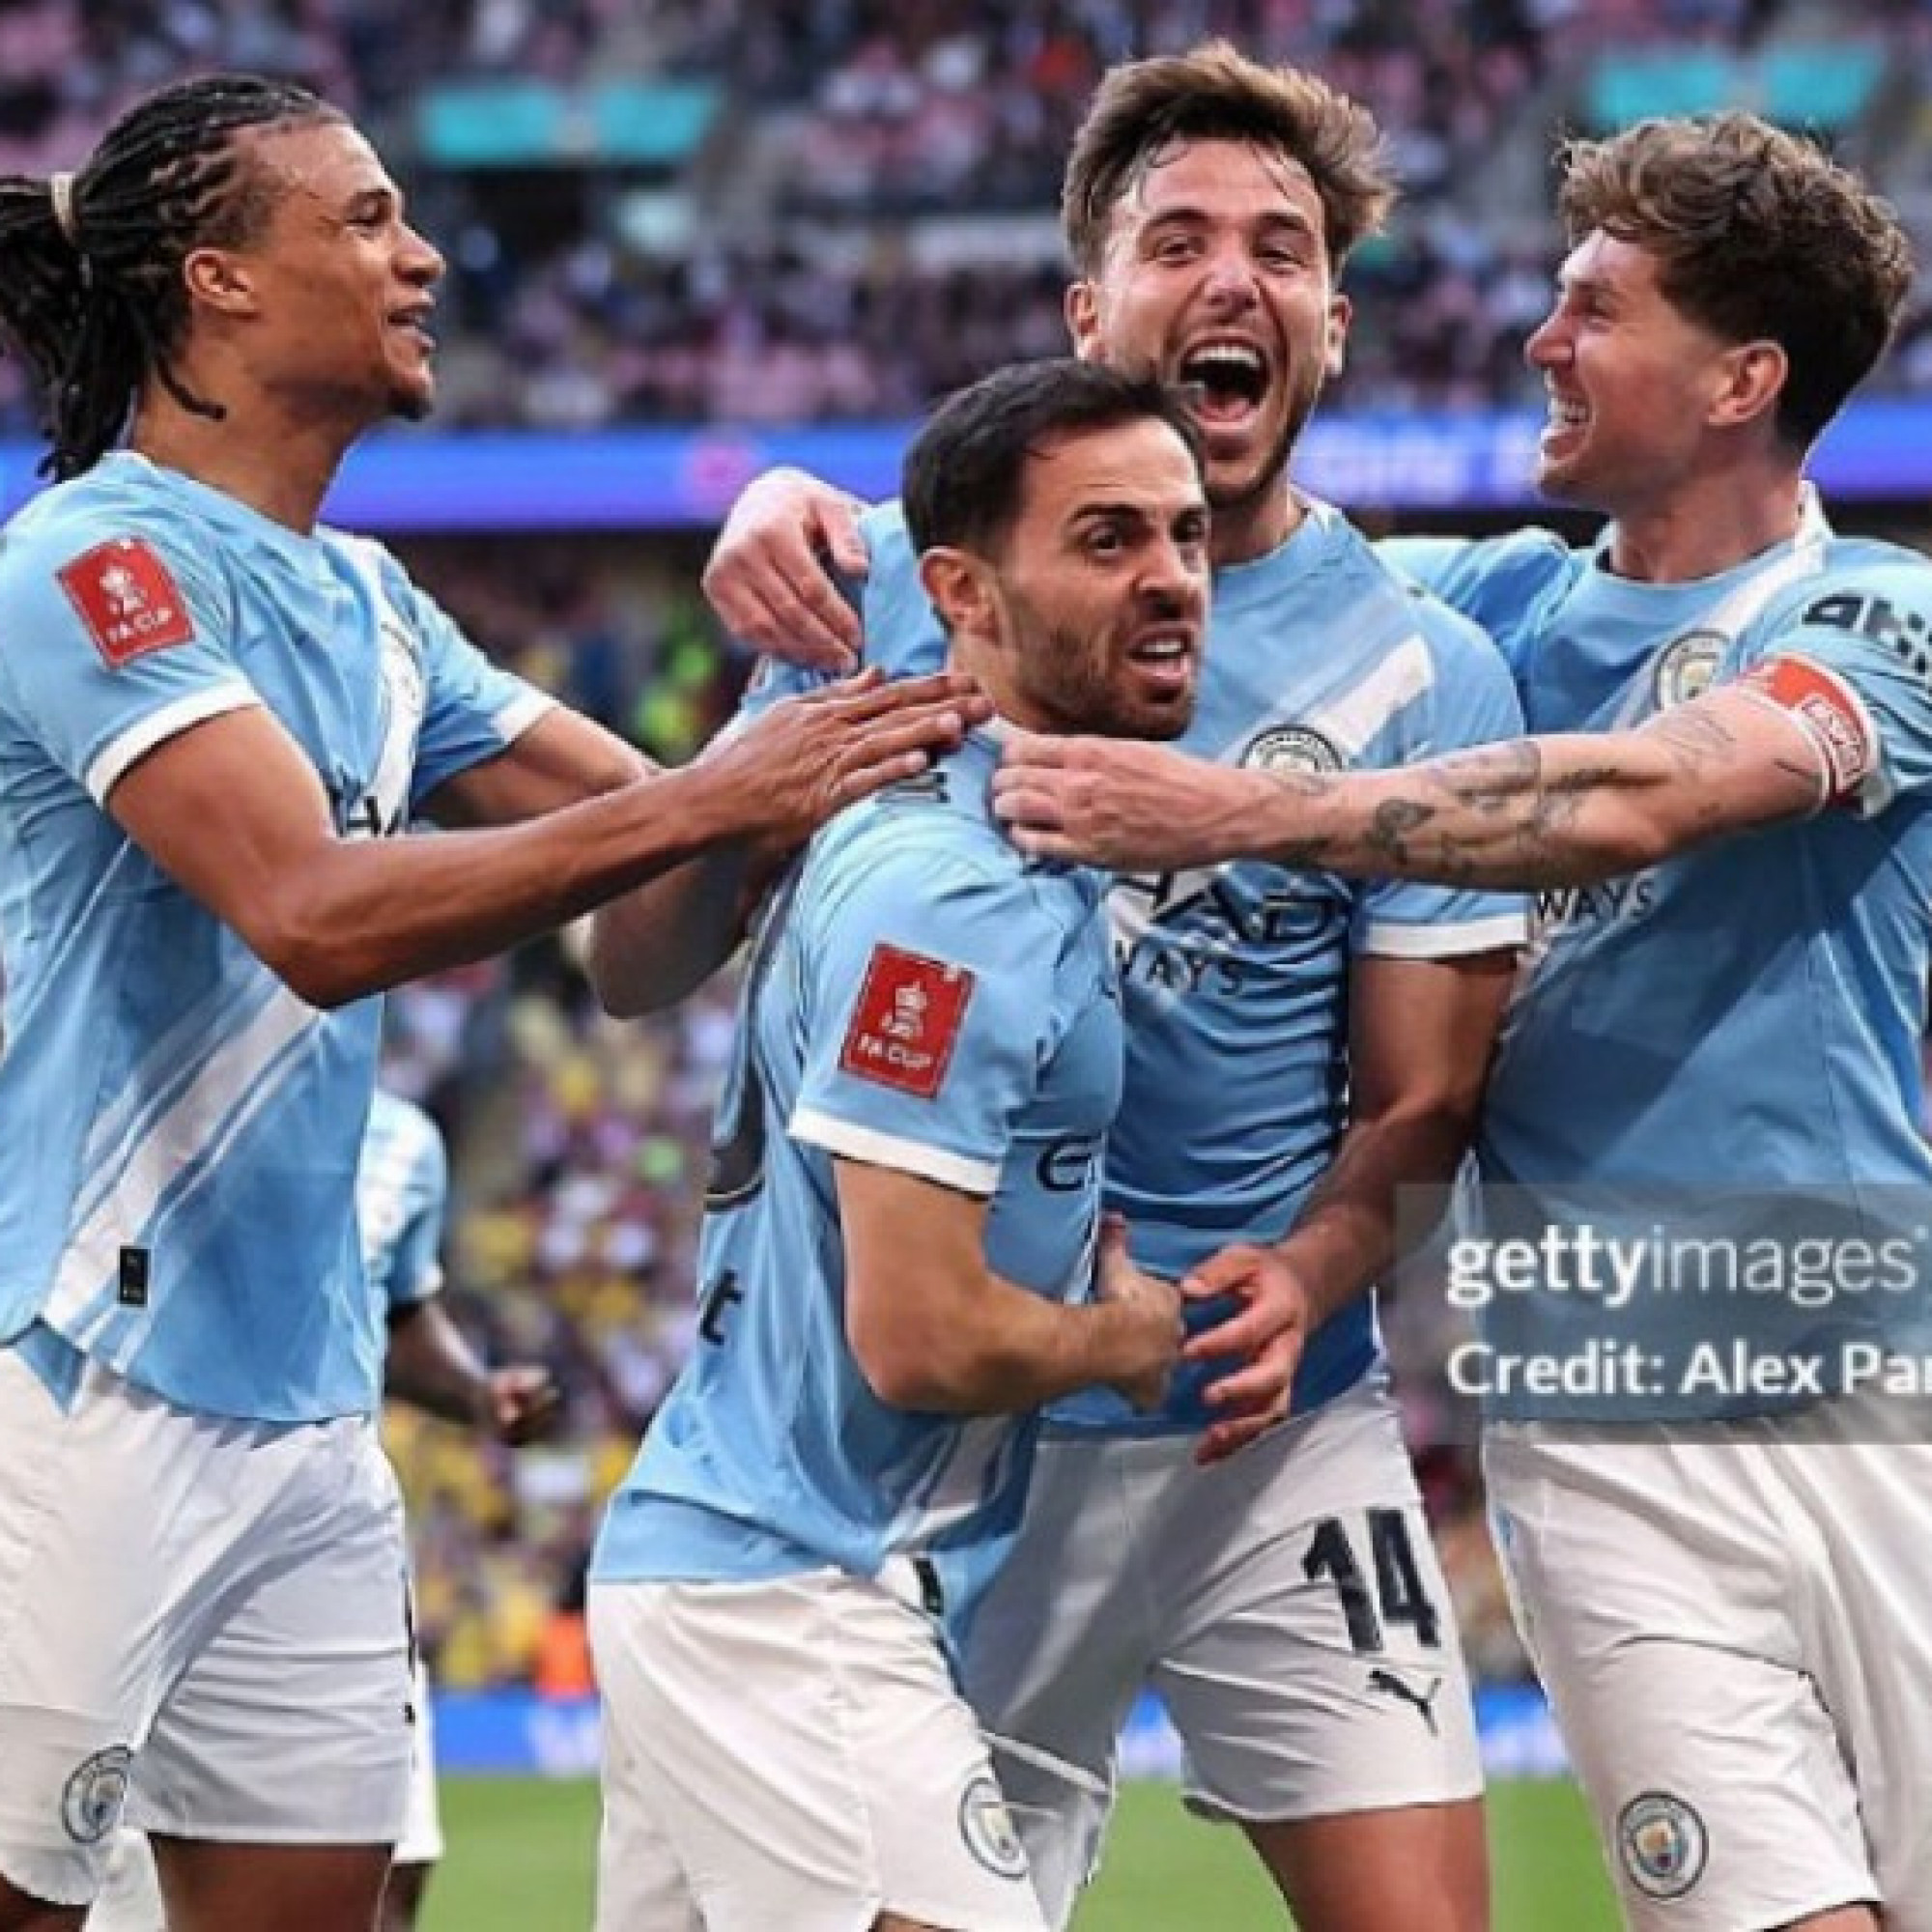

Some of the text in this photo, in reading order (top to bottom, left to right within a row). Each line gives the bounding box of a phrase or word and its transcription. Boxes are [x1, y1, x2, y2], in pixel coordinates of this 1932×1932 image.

[1536, 874, 1655, 921] WAYS
[857, 1032, 932, 1070] FA CUP
[1300, 1508, 1441, 1654] 14
